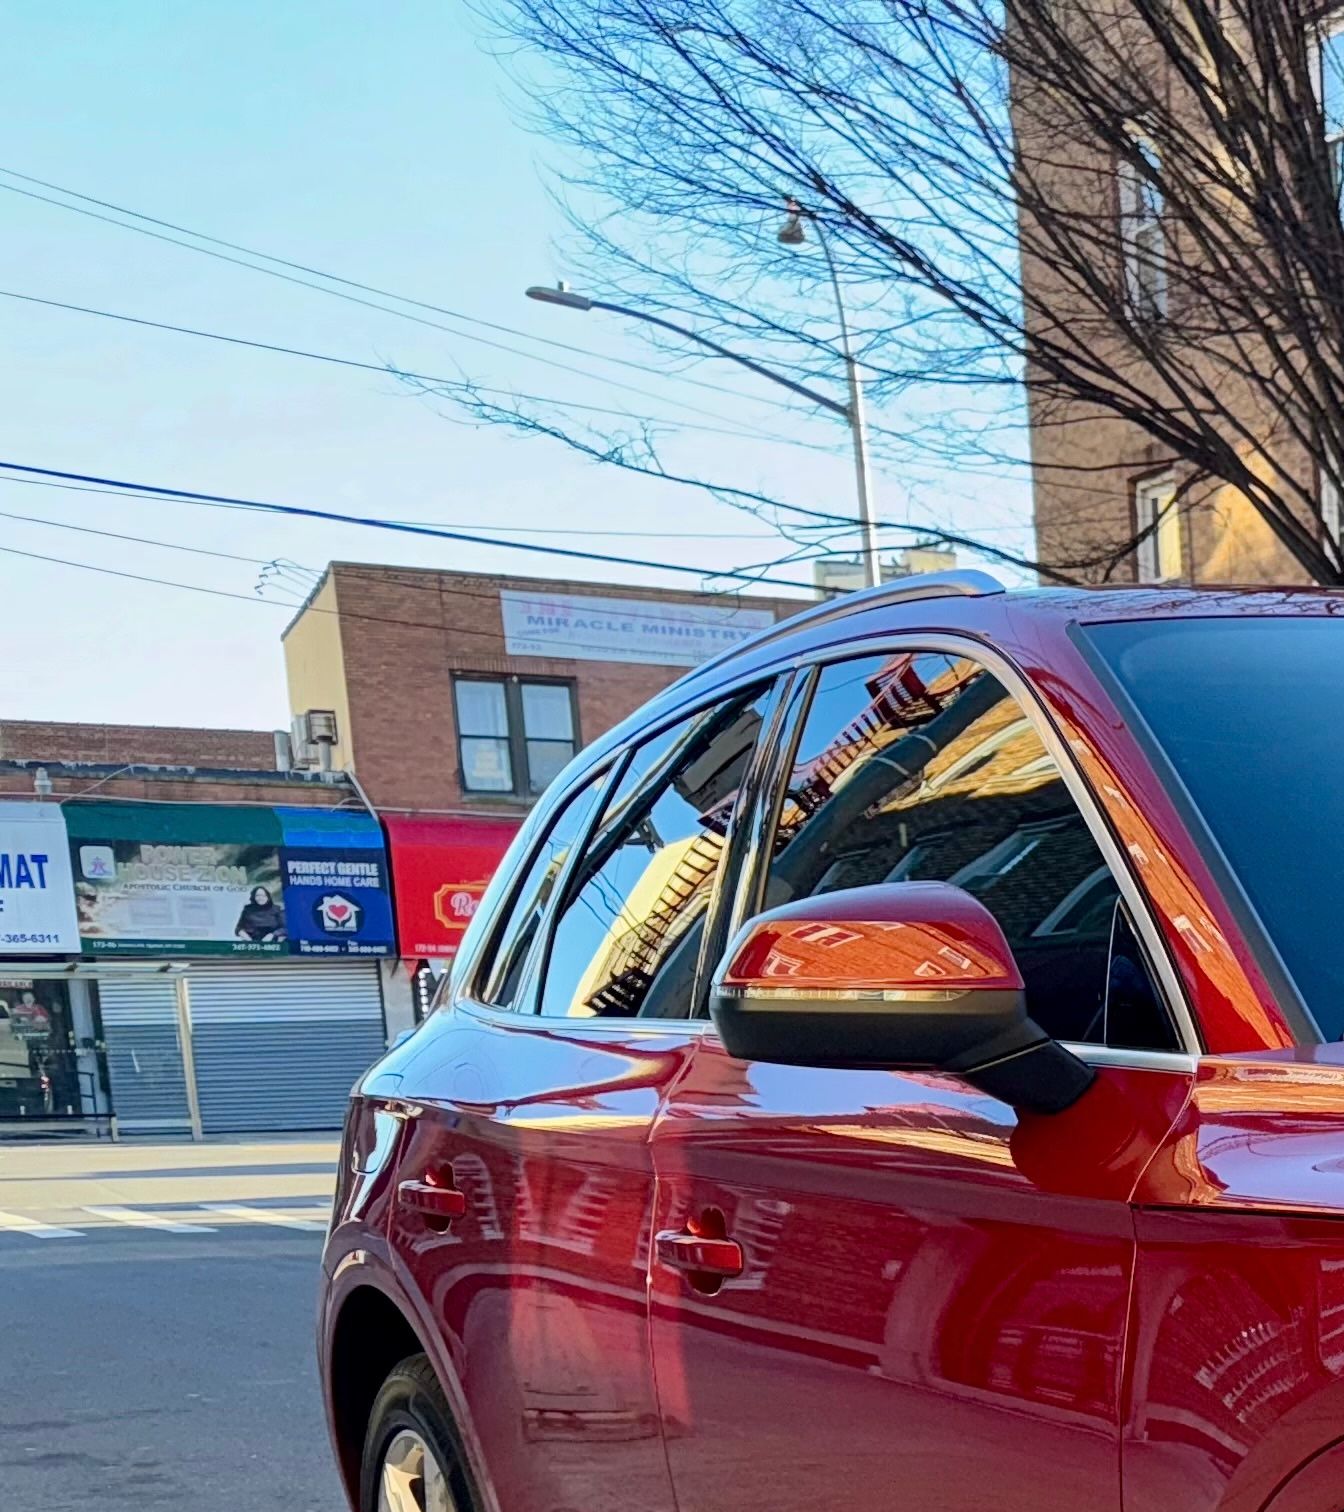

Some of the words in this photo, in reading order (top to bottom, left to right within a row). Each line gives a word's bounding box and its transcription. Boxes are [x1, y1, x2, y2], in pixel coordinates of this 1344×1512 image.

[526, 614, 635, 633] MIRACLE
[641, 624, 752, 641] MINISTRY
[140, 844, 218, 865] POWER
[117, 862, 193, 881] HOUSE
[195, 865, 248, 885] ZION
[287, 861, 336, 875] PERFECT
[337, 862, 379, 877] GENTLE
[289, 875, 323, 886] HANDS
[324, 876, 352, 887] HOME
[353, 877, 380, 888] CARE
[0, 934, 60, 944] -365-6311
